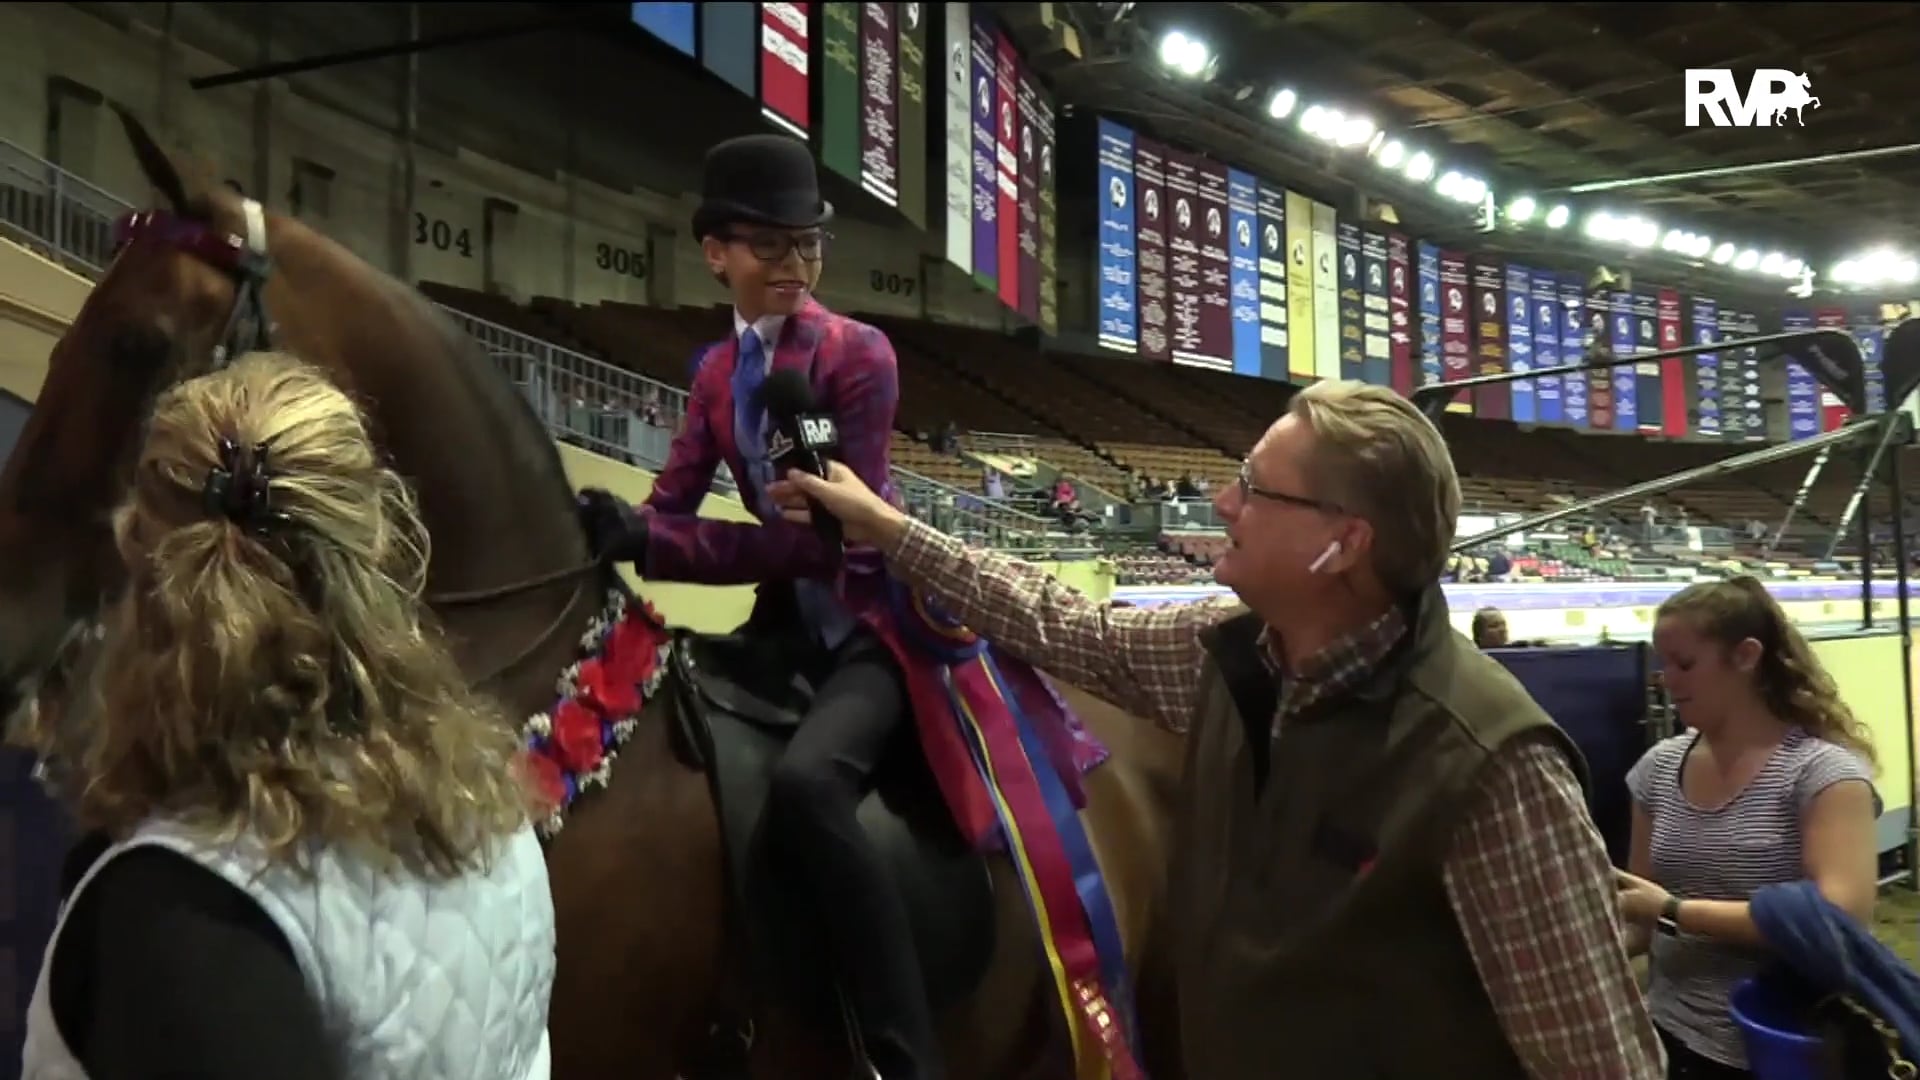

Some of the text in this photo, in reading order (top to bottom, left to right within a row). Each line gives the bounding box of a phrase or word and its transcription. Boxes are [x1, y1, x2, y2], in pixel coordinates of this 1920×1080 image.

[415, 212, 473, 258] 304
[595, 242, 646, 279] 305
[869, 270, 916, 297] 307
[802, 418, 832, 443] RVP
